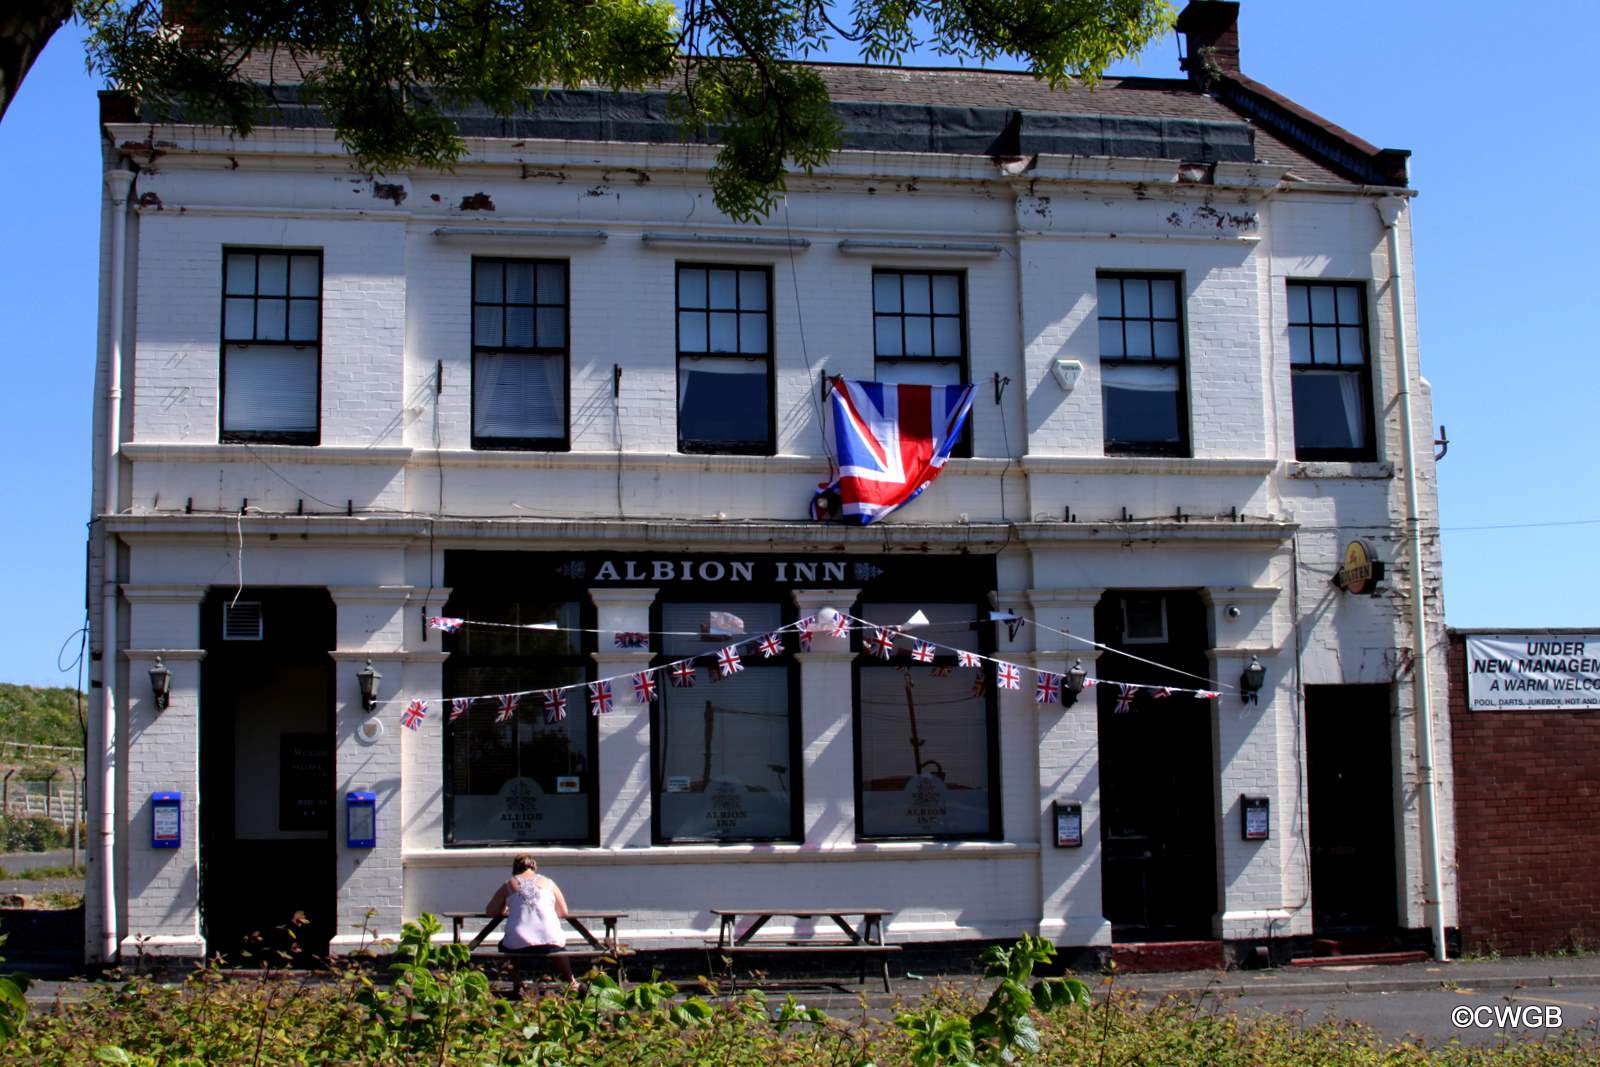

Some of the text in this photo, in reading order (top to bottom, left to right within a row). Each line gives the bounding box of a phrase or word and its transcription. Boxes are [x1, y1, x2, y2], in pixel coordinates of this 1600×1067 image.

[594, 560, 847, 582] ALBION INN
[1527, 641, 1585, 656] UNDER
[1474, 659, 1513, 674] NEW
[1490, 679, 1500, 691] A
[1504, 678, 1549, 692] WARM
[1474, 698, 1497, 707] POOL,
